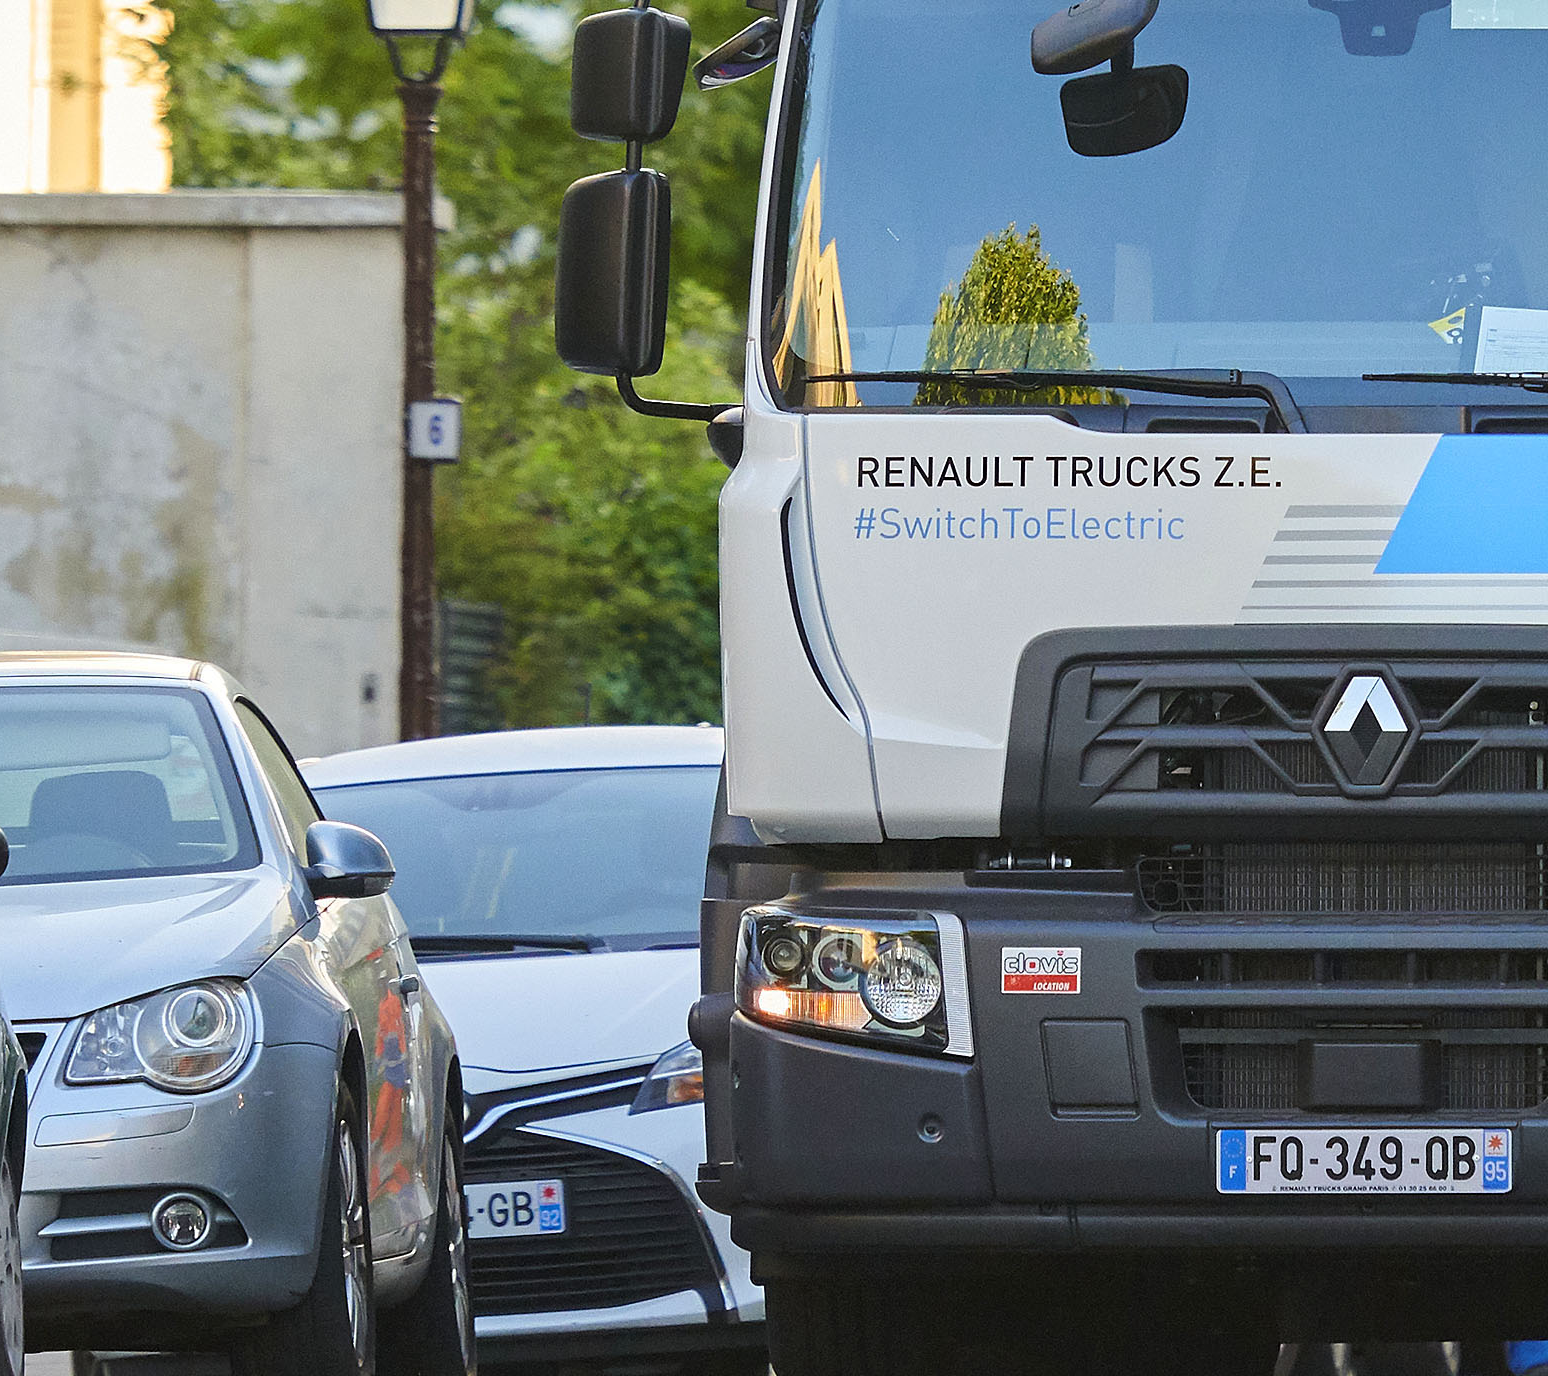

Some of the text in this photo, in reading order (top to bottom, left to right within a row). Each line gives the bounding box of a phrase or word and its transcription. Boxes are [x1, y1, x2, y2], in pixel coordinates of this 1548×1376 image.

[428, 414, 444, 446] 6
[856, 455, 1284, 489] RENAULT TRUCKS Z.E.
[854, 507, 1185, 540] #SwitchToElectric
[1004, 950, 1078, 974] clovis
[1033, 981, 1070, 991] LOCATION
[1252, 1135, 1477, 1182] FQ-349-QB
[1229, 1165, 1238, 1179] F
[1484, 1160, 1508, 1182] 95
[1279, 1185, 1311, 1193] RENAULT
[1313, 1185, 1341, 1193] TRUCKS
[468, 1191, 534, 1228] -GB
[540, 1208, 561, 1228] 92
